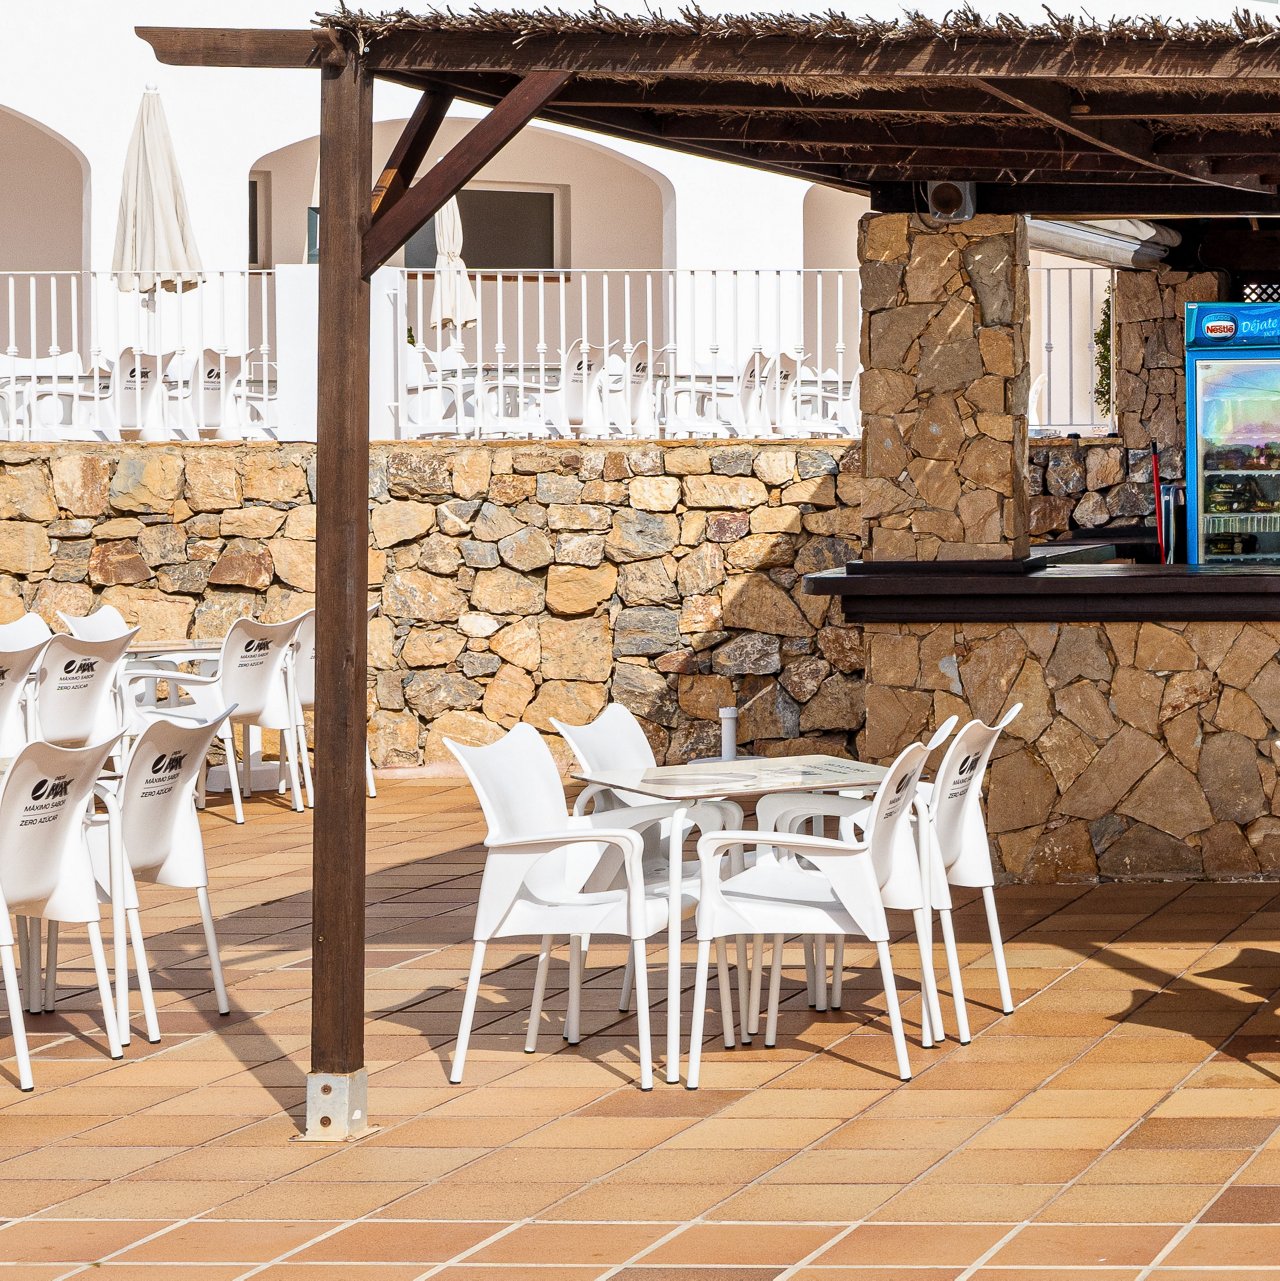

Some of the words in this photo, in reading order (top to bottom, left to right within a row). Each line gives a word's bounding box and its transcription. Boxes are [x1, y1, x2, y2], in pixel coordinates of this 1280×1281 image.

[1241, 318, 1278, 333] Déjate
[75, 661, 98, 674] MAX
[45, 779, 74, 800] MAX
[156, 786, 173, 796] AZÚCAR
[24, 802, 50, 812] MÁXIMO
[50, 799, 67, 809] SABOR
[19, 819, 38, 827] ZERO
[38, 814, 58, 824] AZÚCAR
